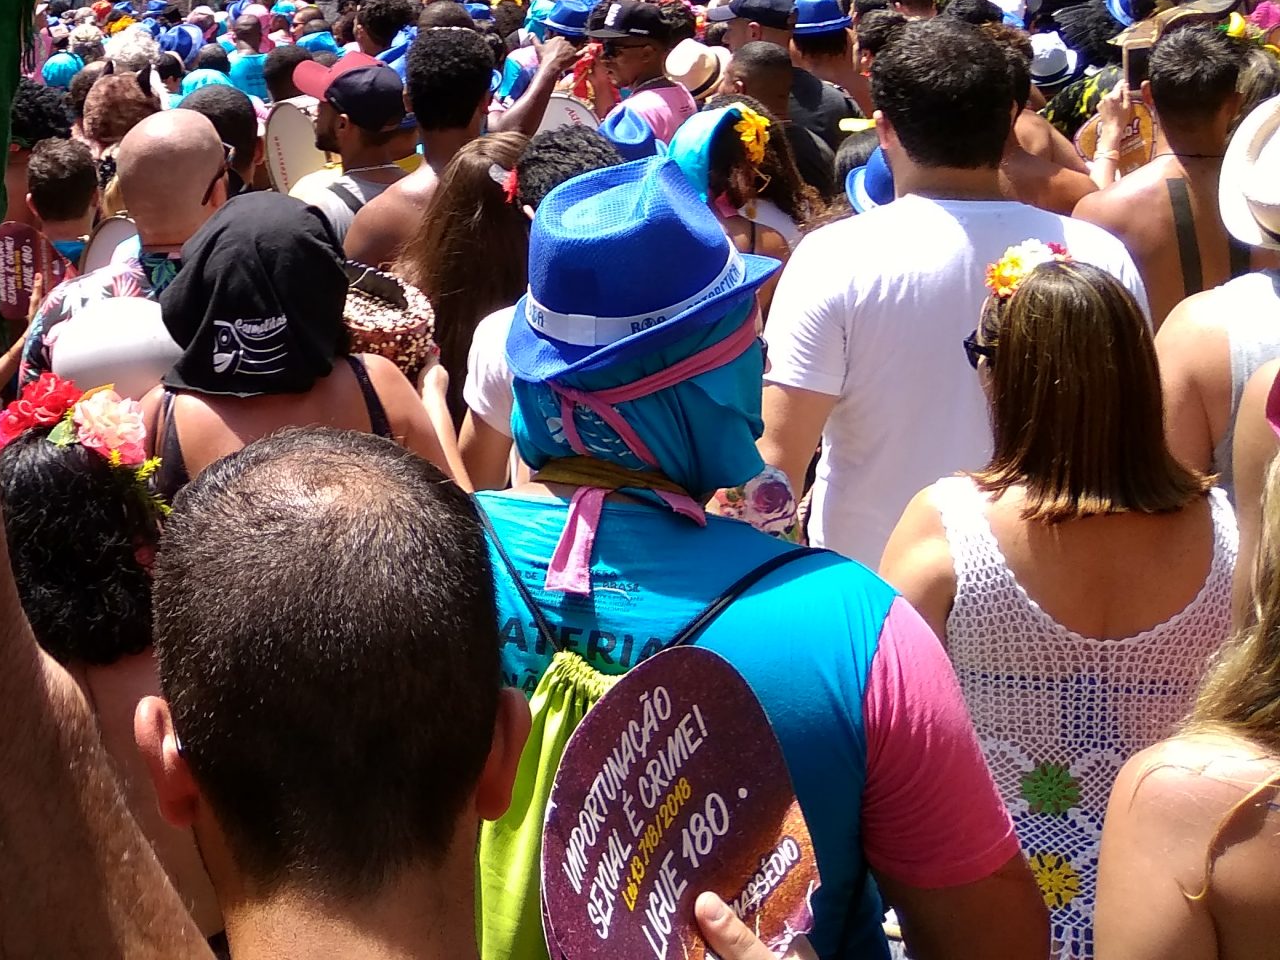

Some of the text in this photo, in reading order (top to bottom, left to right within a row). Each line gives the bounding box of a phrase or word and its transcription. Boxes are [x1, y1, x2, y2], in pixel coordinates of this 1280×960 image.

[497, 616, 666, 669] ATERIA
[562, 686, 671, 895] IMPORTUNAÇÃO
[587, 704, 709, 940] SEXUAL É CRIME!
[642, 792, 730, 960] LIGUE 180
